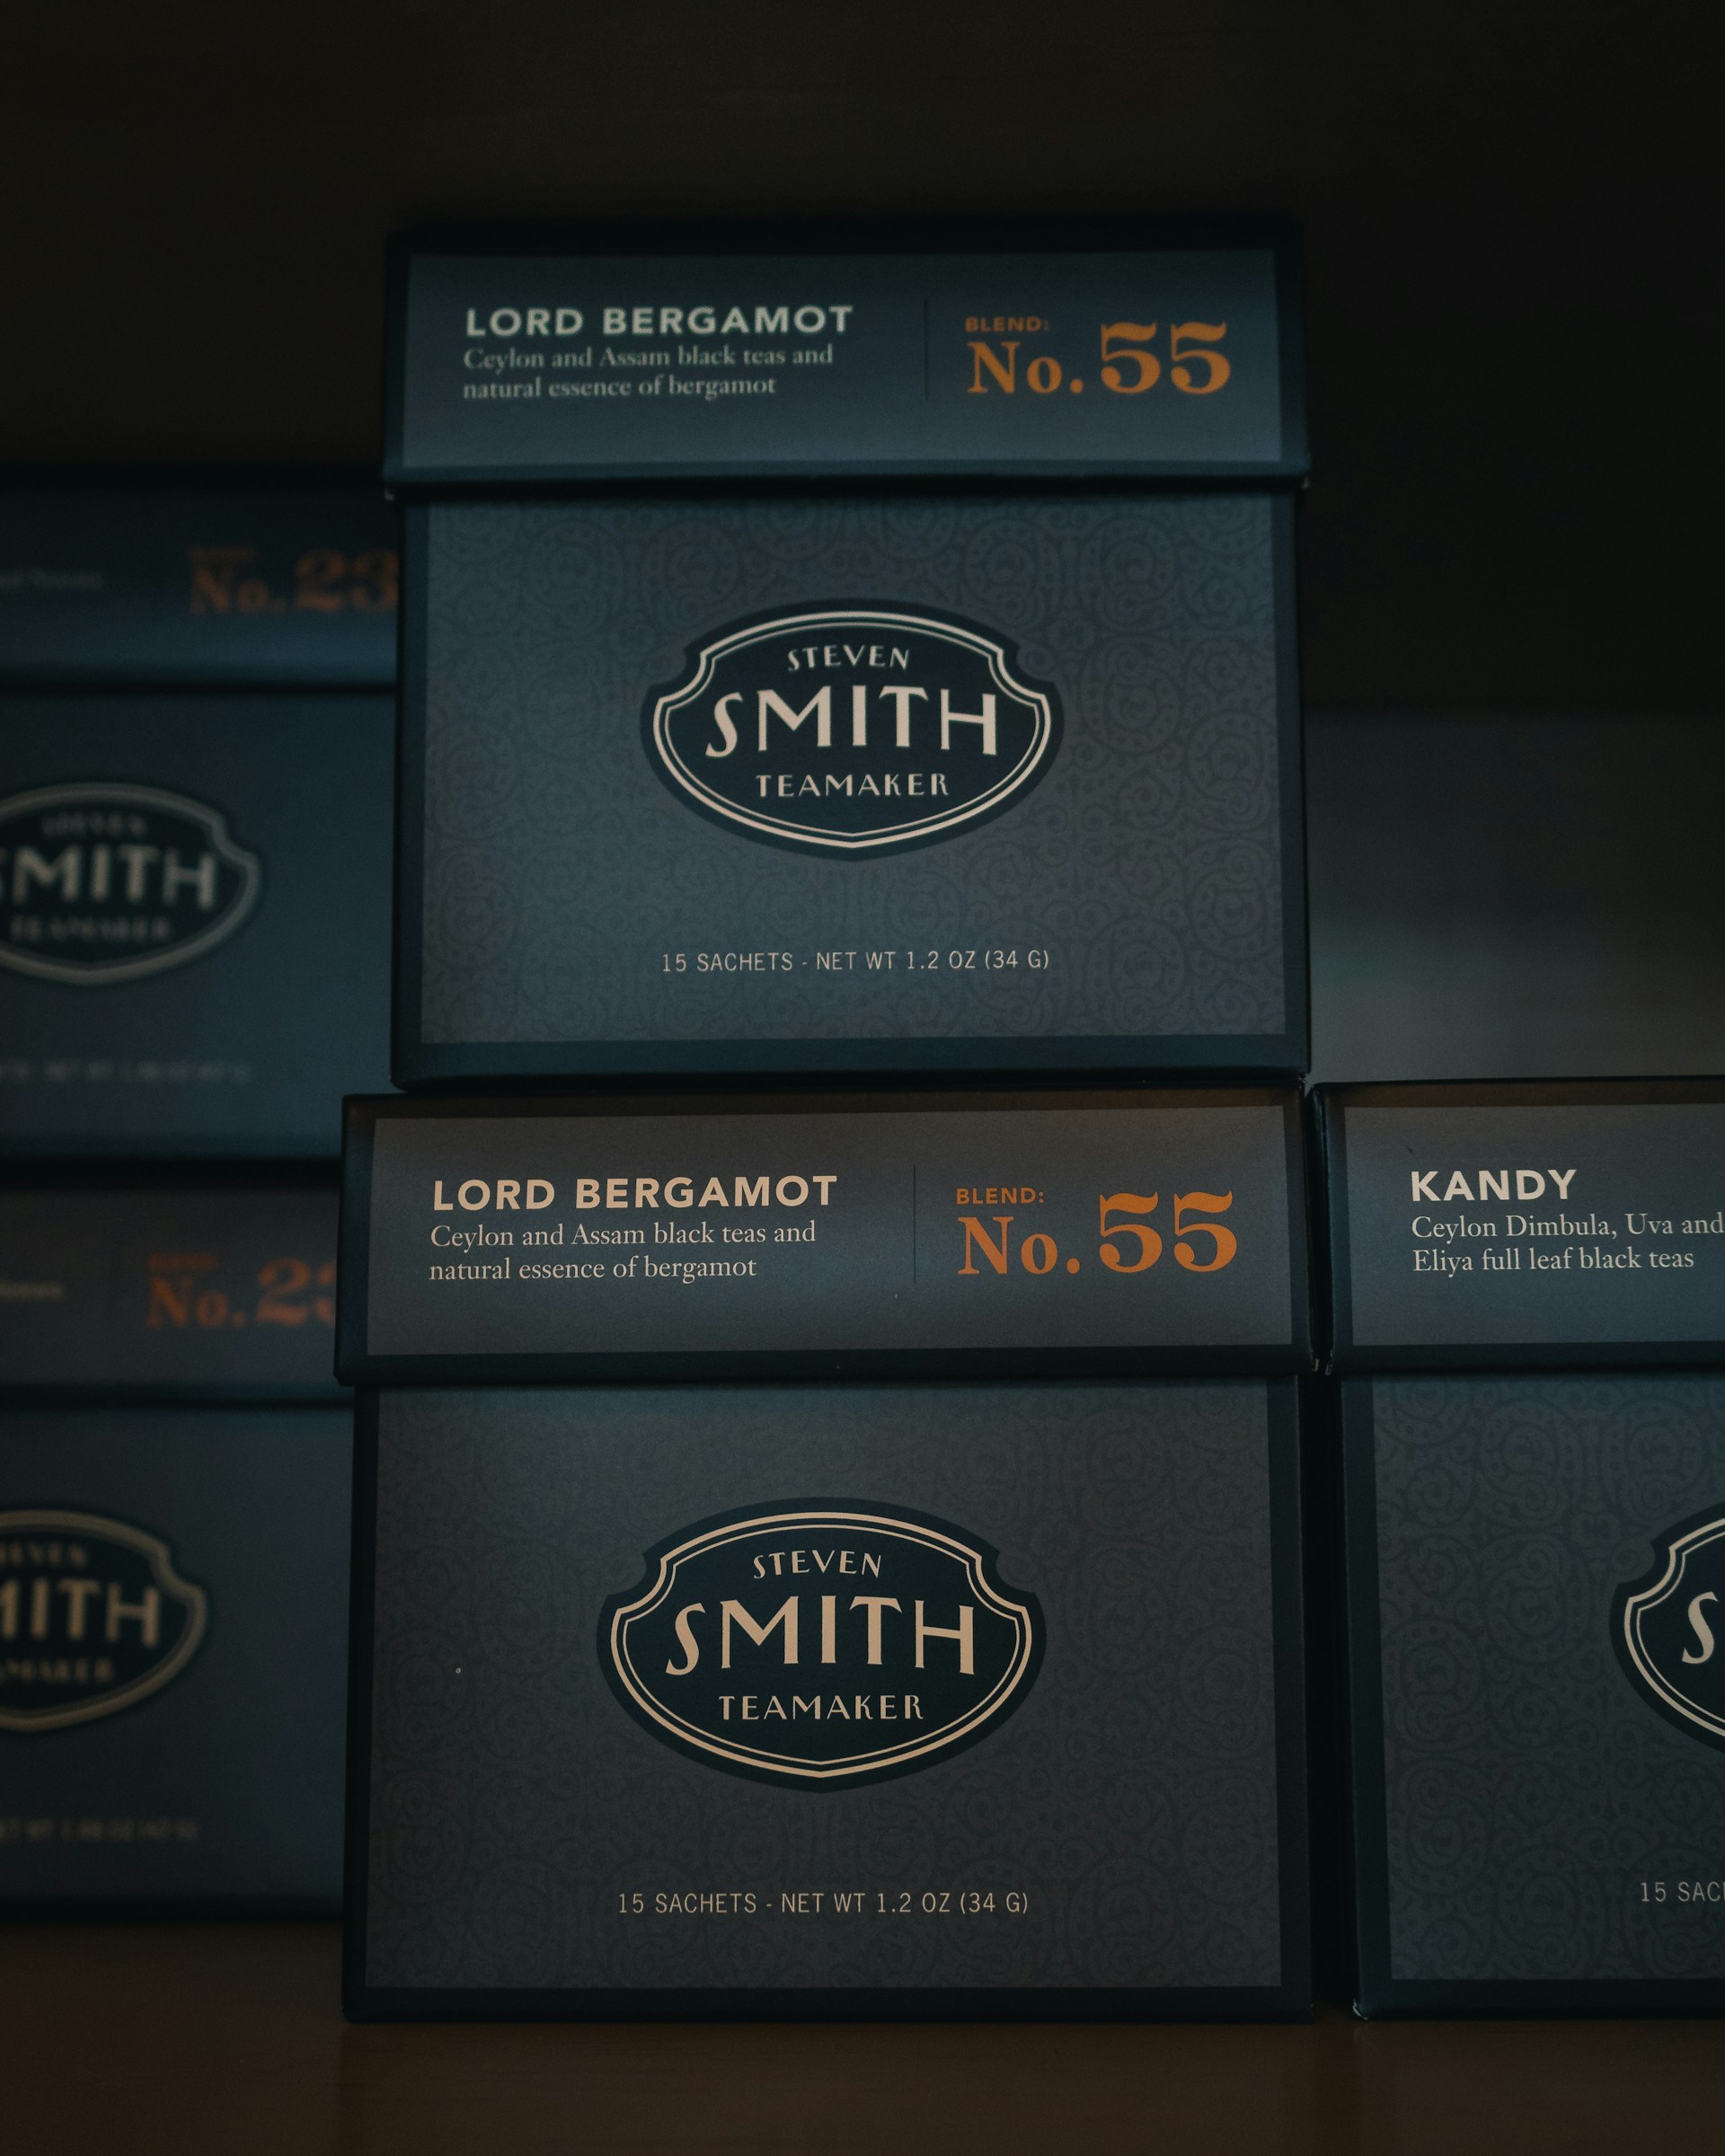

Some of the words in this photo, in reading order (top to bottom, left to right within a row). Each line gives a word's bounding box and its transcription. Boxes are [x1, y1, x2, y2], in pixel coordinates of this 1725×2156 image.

[466, 307, 584, 338] LORD
[602, 305, 854, 335] BERGAMOT
[964, 315, 1048, 333] BLEND:
[462, 345, 546, 376] Ceylon
[552, 346, 593, 368] and
[599, 347, 670, 367] Assam
[677, 344, 736, 366] black
[743, 345, 787, 366] teas
[792, 343, 834, 365] and
[968, 340, 1084, 394] No.
[1100, 322, 1231, 395] 55
[462, 376, 543, 401] natural
[548, 382, 632, 398] essence
[638, 374, 664, 396] of
[668, 374, 775, 402] bergamot
[787, 644, 909, 671] STEVEN
[703, 684, 998, 759] SMITH
[756, 773, 949, 798] TEAMAKER
[0, 842, 218, 913] MITH
[662, 952, 687, 973] 15
[696, 951, 793, 973] SACHETS
[816, 950, 857, 971] NET
[865, 950, 897, 970] WT
[907, 950, 939, 970] 1.2
[948, 950, 977, 970] OZ
[984, 950, 1019, 970] (34
[1027, 949, 1049, 970] G)
[433, 1179, 555, 1212] LORD
[575, 1174, 838, 1209] BERGAMOT
[955, 1186, 1044, 1206] BLEND:
[1411, 1169, 1577, 1203] KANDY
[429, 1223, 517, 1254] Ceylon
[522, 1223, 564, 1246] and
[571, 1224, 646, 1245] Assam
[653, 1221, 715, 1244] black
[721, 1224, 768, 1245] teas
[774, 1219, 816, 1243] and
[958, 1215, 1081, 1276] No.
[1098, 1190, 1237, 1274] 55
[1410, 1213, 1499, 1247] Ceylon
[1505, 1213, 1618, 1240] Dimbula,
[1624, 1213, 1674, 1235] Uva
[1681, 1211, 1725, 1234] and
[428, 1256, 512, 1282] natural
[518, 1263, 606, 1280] essence
[612, 1254, 640, 1278] of
[643, 1254, 756, 1285] bergamot
[1413, 1248, 1473, 1278] Eliya
[1482, 1247, 1521, 1271] full
[1529, 1246, 1574, 1270] leaf
[1579, 1245, 1642, 1269] black
[1648, 1247, 1696, 1269] teas
[146, 1276, 247, 1331] No.
[753, 1549, 881, 1579] STEVEN
[663, 1593, 978, 1677] SMITH
[718, 1694, 924, 1721] TEAMAKER
[619, 1893, 644, 1914] 15
[655, 1892, 757, 1914] SACHETS
[781, 1892, 825, 1913] NET
[833, 1892, 866, 1913] WT
[877, 1892, 912, 1913] 1.2
[921, 1892, 951, 1913] OZ
[960, 1891, 996, 1914] (34
[1005, 1891, 1029, 1914] G)
[1641, 1881, 1667, 1903] 15
